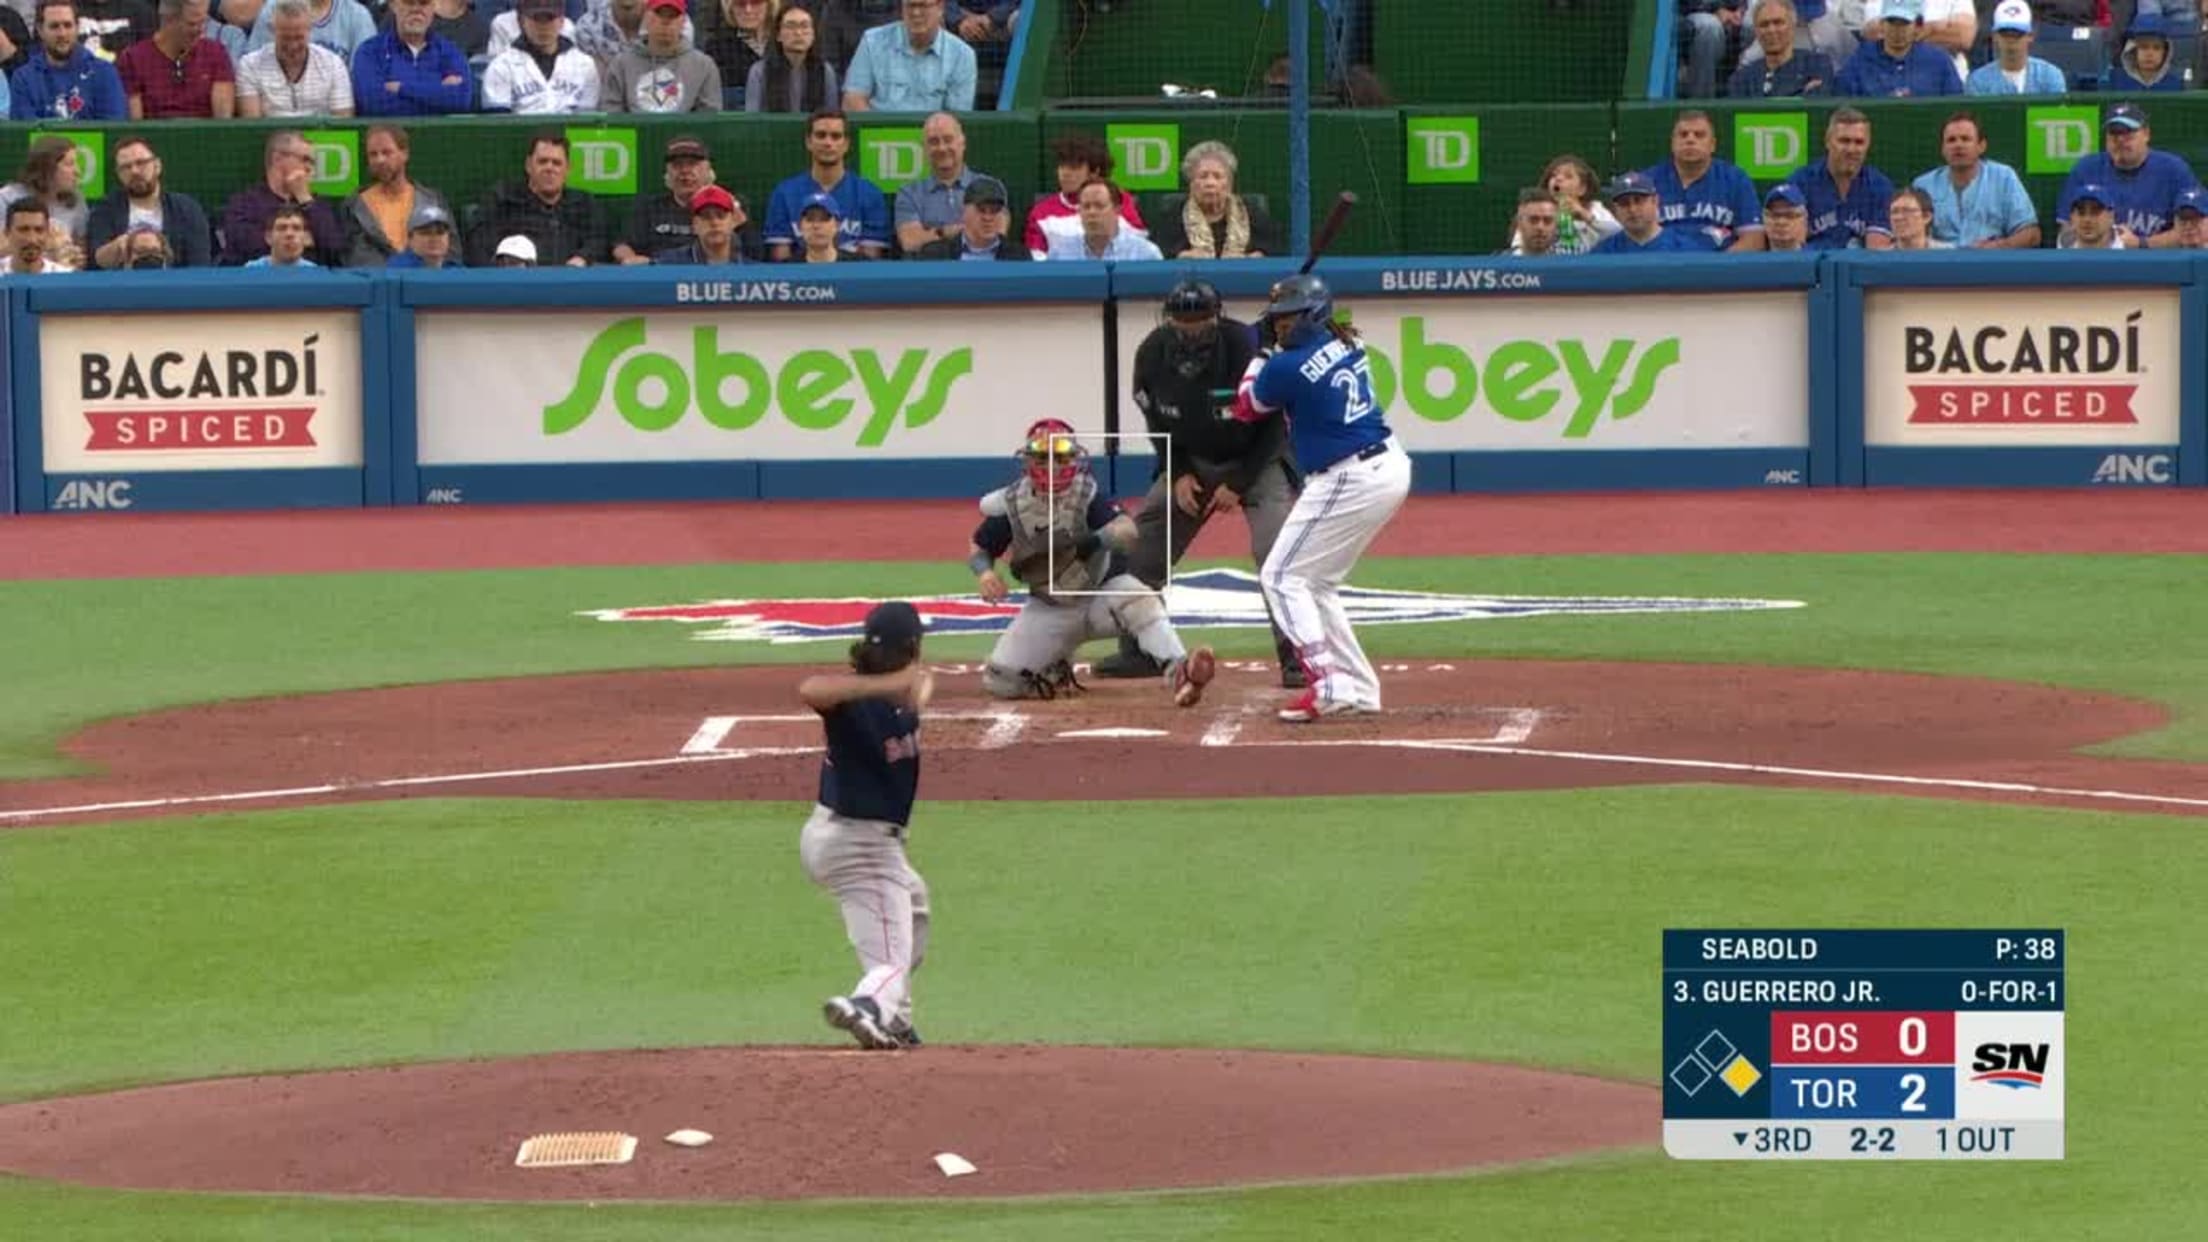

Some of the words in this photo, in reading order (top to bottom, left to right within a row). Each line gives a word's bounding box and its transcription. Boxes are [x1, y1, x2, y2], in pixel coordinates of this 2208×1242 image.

[1115, 137, 1171, 176] TD
[1413, 130, 1470, 169] TD
[1743, 126, 1800, 166] TD
[2036, 120, 2093, 159] TD
[315, 142, 350, 182] D
[573, 141, 629, 181] TD
[1657, 203, 1686, 222] LUE
[1905, 310, 2142, 373] BACARDÍ
[80, 332, 319, 400] BACARDÍ
[543, 316, 973, 447] Sobeys
[1940, 391, 2106, 417] SPICED
[117, 415, 285, 443] SPICED
[2092, 454, 2170, 483] ANC
[52, 480, 132, 509] ANC
